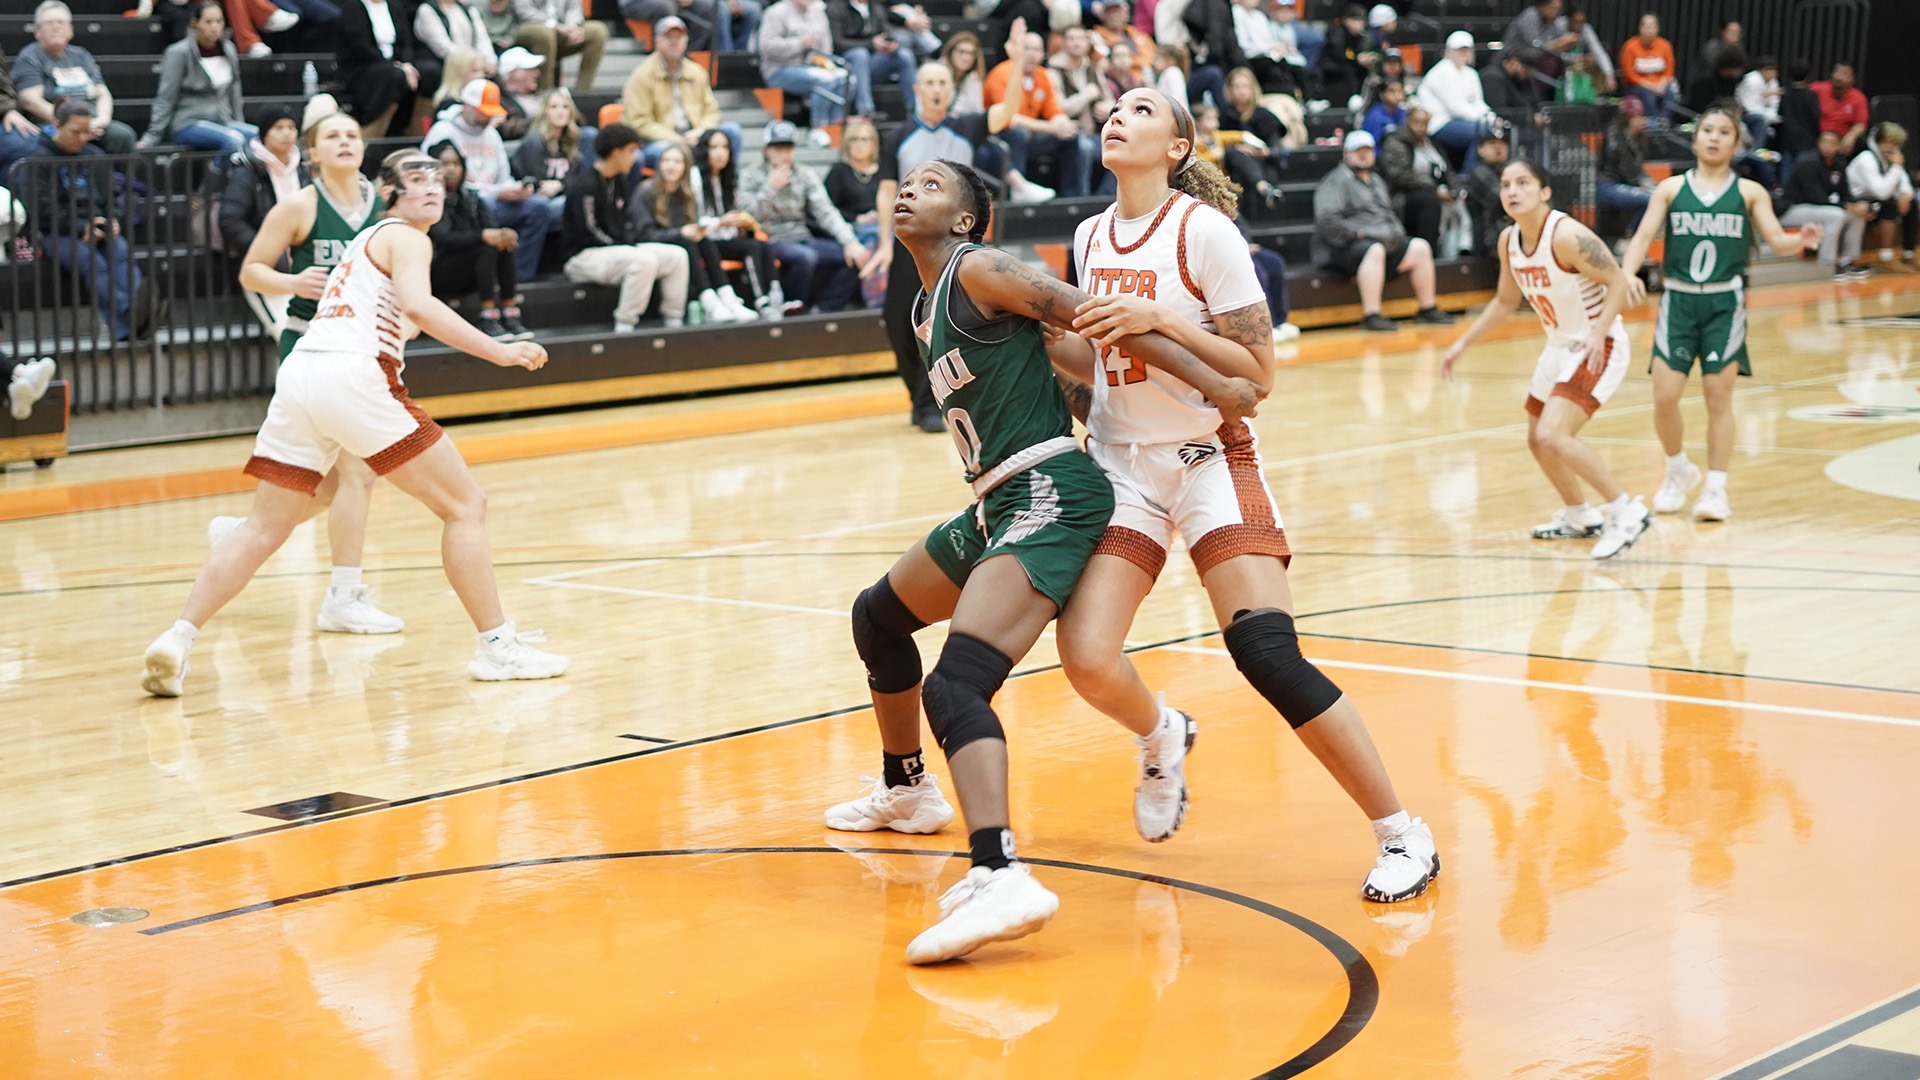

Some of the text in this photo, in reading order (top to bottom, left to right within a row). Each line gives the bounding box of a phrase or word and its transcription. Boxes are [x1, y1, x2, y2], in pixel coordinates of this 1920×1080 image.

[1670, 212, 1744, 238] ENMU
[313, 239, 352, 267] EN
[1689, 240, 1717, 282] 0
